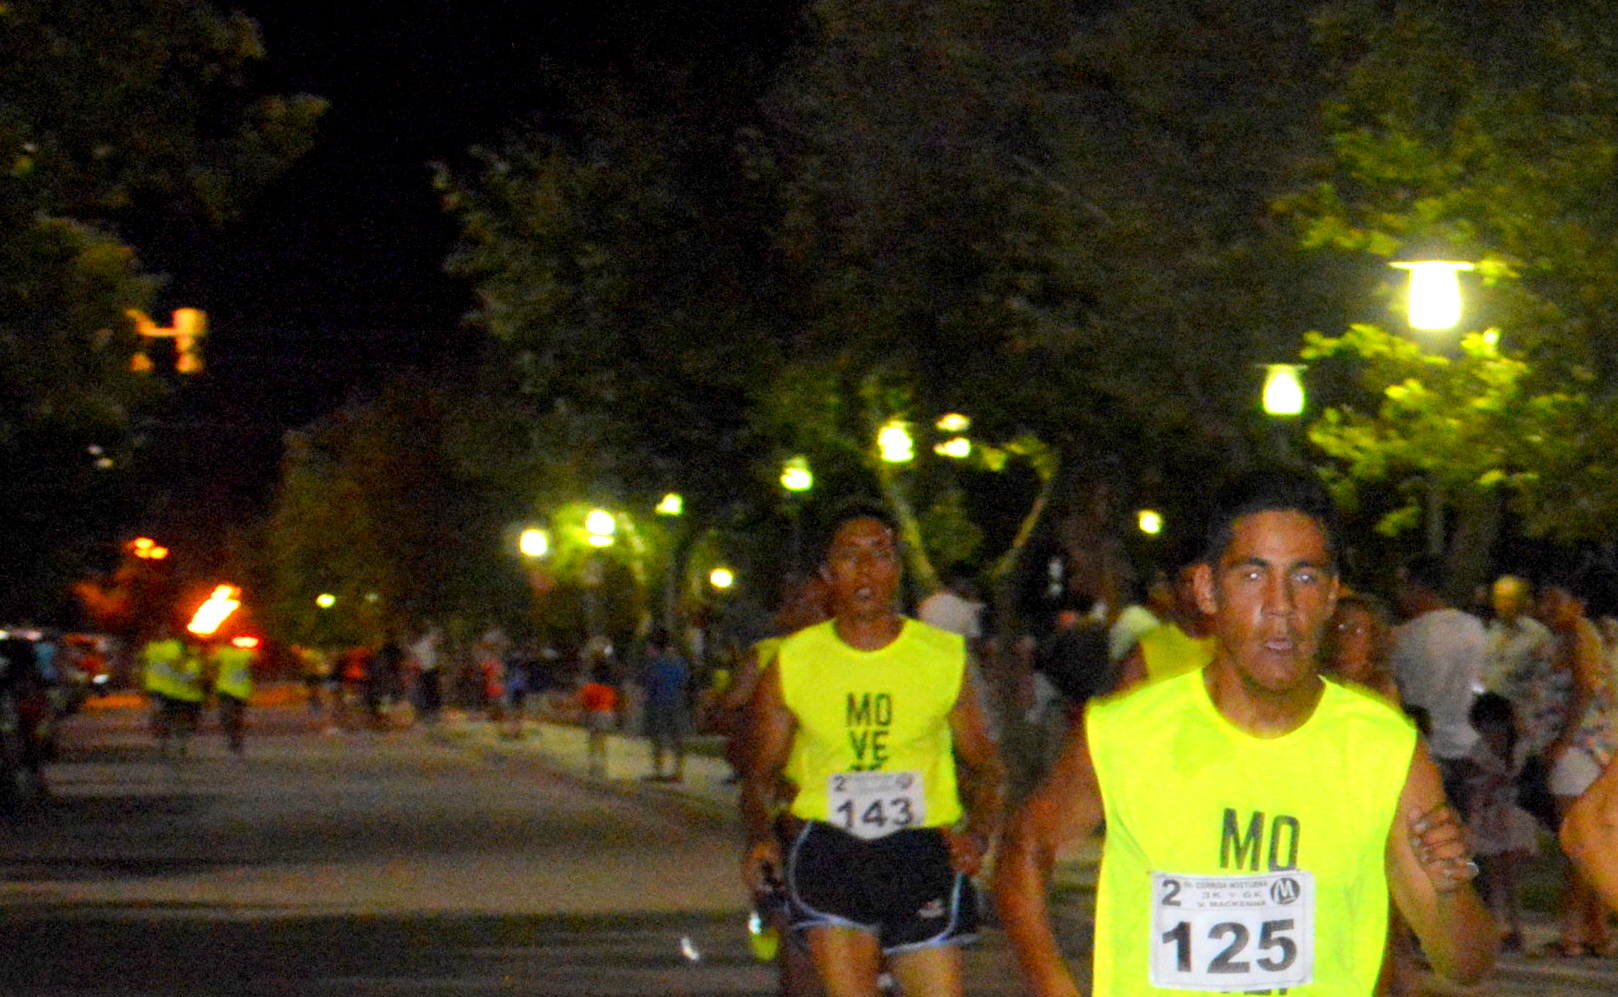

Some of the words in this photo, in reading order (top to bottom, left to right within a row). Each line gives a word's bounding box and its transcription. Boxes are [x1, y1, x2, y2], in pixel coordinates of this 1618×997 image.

[846, 692, 893, 727] MO
[850, 730, 890, 762] VE
[833, 775, 847, 792] 2
[836, 797, 914, 829] 143
[1219, 808, 1301, 872] MO
[1161, 880, 1182, 907] 2
[1161, 918, 1297, 974] 125
